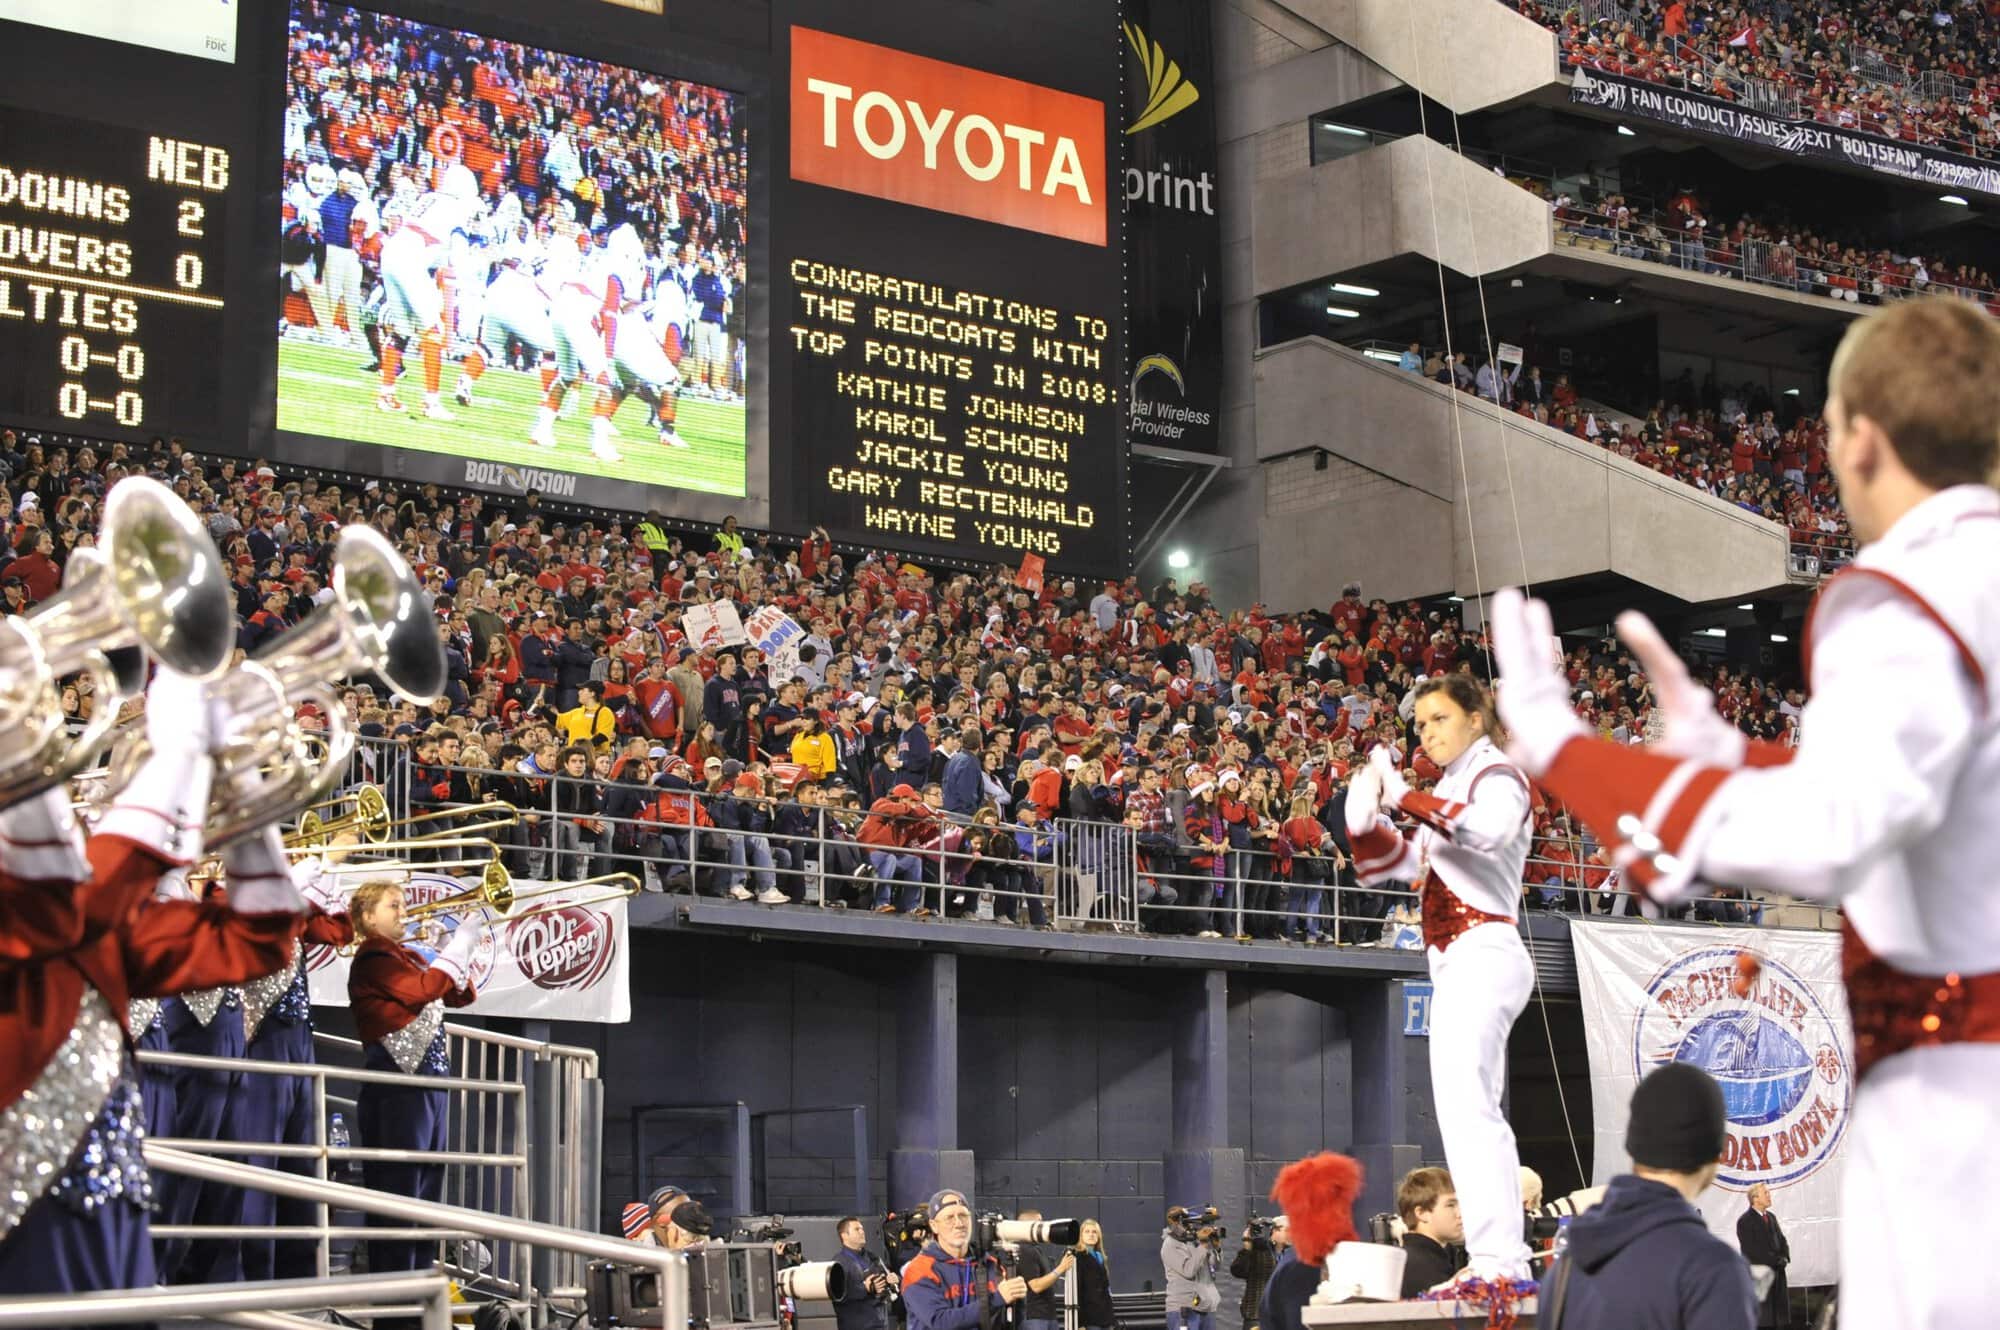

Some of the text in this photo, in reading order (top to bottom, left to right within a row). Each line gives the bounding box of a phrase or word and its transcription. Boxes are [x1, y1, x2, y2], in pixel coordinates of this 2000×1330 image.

[205, 39, 227, 52] FDIC
[807, 77, 1093, 206] TOYOTA
[1630, 86, 1663, 111] FAN
[1664, 95, 1735, 128] CONDUCT
[1737, 112, 1790, 141] ISSUES
[1794, 126, 1832, 150] TEXT
[1834, 134, 1922, 168] "BOLTSFAN"
[147, 136, 230, 191] NEB
[177, 200, 205, 237] 2
[175, 253, 203, 289] 0
[790, 259, 1108, 341] CONGRATULATIONS TO
[800, 292, 1100, 370] THE REDCOATS WITH
[61, 335, 145, 382] 0-0
[790, 326, 1117, 404] TOP POINTS IN 2008:
[59, 382, 143, 427] 0-0
[837, 371, 1084, 435] KATHIE JOHNSON
[1131, 416, 1185, 440] Provider
[1157, 402, 1210, 425] Wireless
[855, 406, 1068, 463] KAROL SCHOEN
[465, 460, 577, 497] BOLT VISION
[856, 440, 1068, 493] JACKIE YOUNG
[828, 467, 1095, 528] GARY RECTENWALD
[865, 504, 1061, 554] WAYNE YOUNG
[758, 618, 801, 657] DOWN
[519, 920, 599, 977] Pepper
[547, 913, 577, 946] Dr
[1656, 965, 1742, 1029] PACIFI
[1773, 1094, 1839, 1167] BOWL
